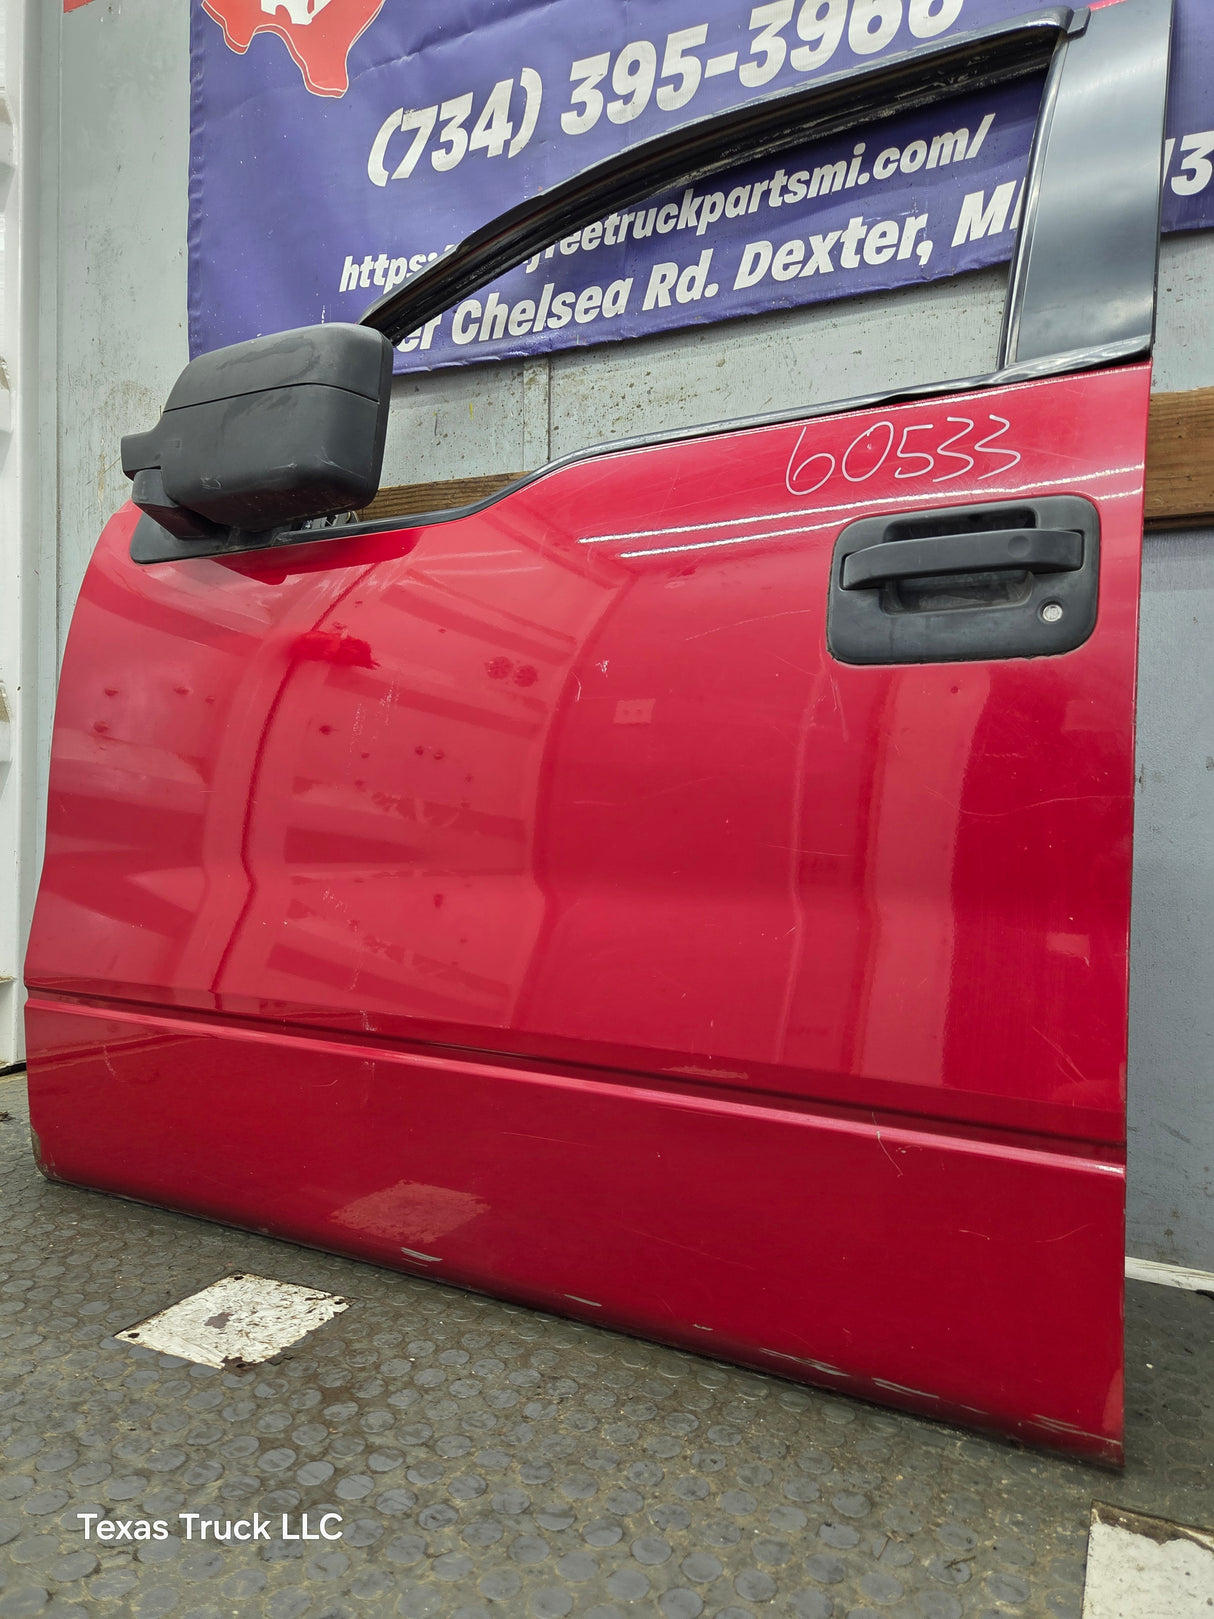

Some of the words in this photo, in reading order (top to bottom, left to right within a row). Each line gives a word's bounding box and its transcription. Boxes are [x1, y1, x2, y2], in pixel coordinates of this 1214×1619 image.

[367, 67, 543, 187] (734)
[451, 277, 634, 345] Chelsea
[641, 248, 720, 311] Rd.
[733, 211, 934, 290] Dexter,
[786, 414, 1021, 496] 60533
